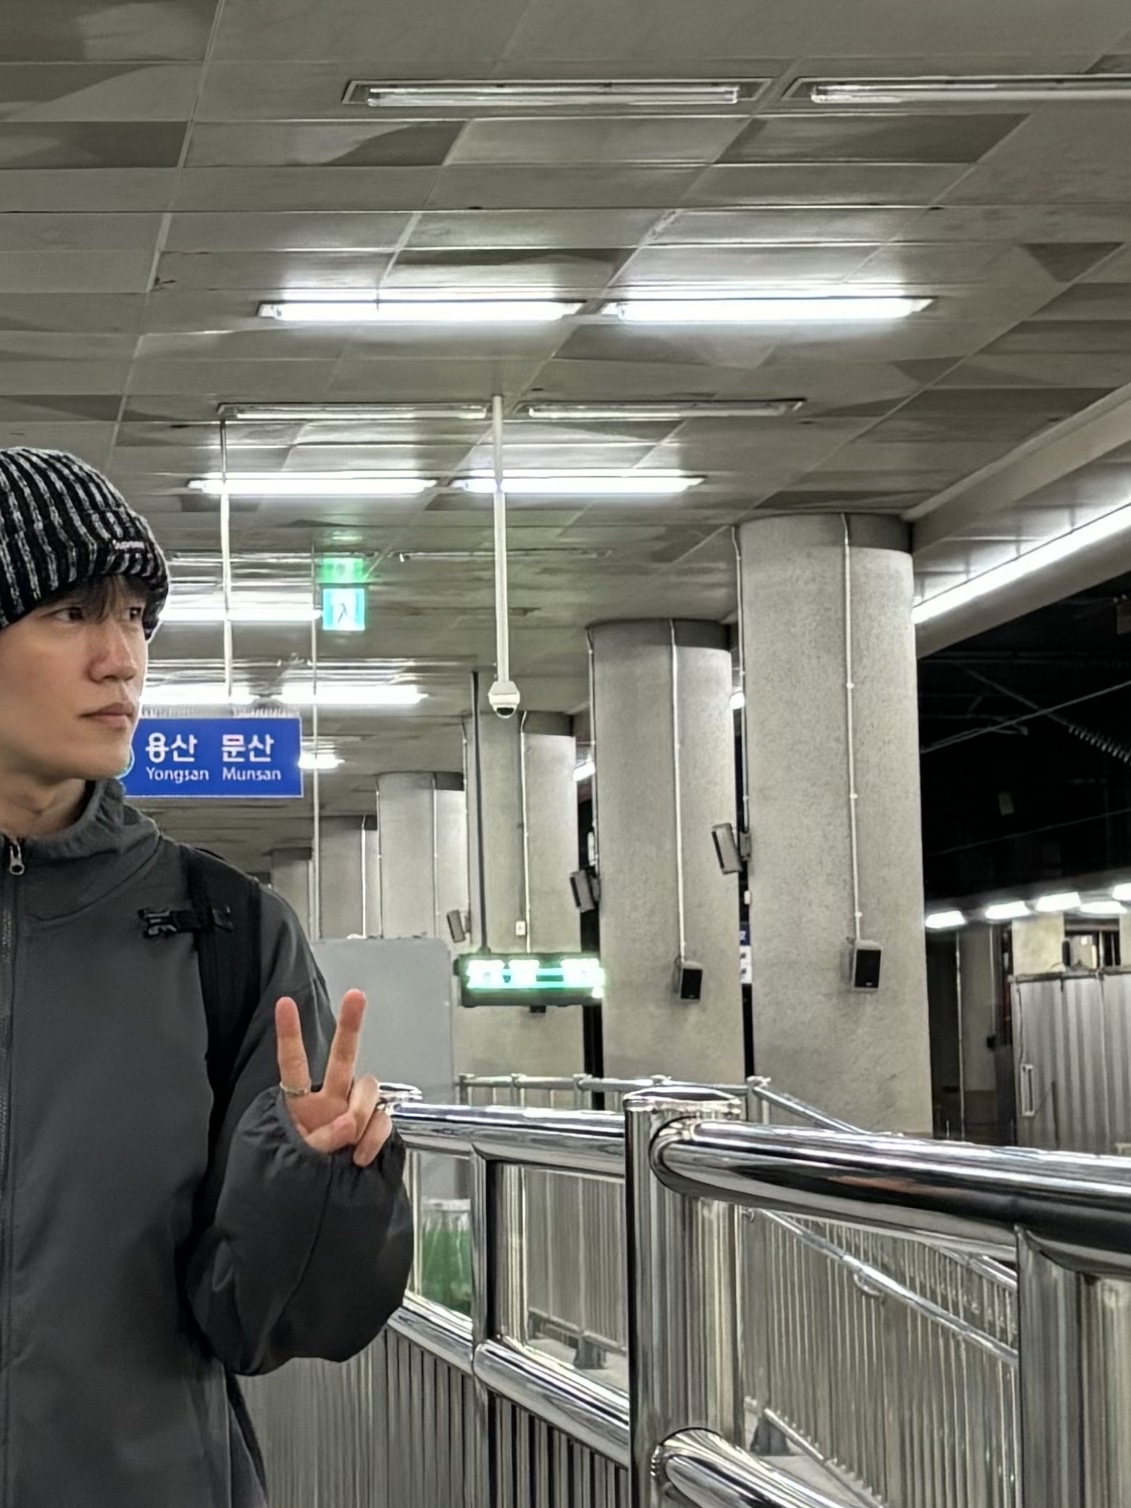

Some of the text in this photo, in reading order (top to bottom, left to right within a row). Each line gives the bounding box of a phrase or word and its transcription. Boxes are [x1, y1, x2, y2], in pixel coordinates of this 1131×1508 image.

[145, 732, 275, 763] 용산 문산
[146, 766, 282, 784] Yongsan Munsan
